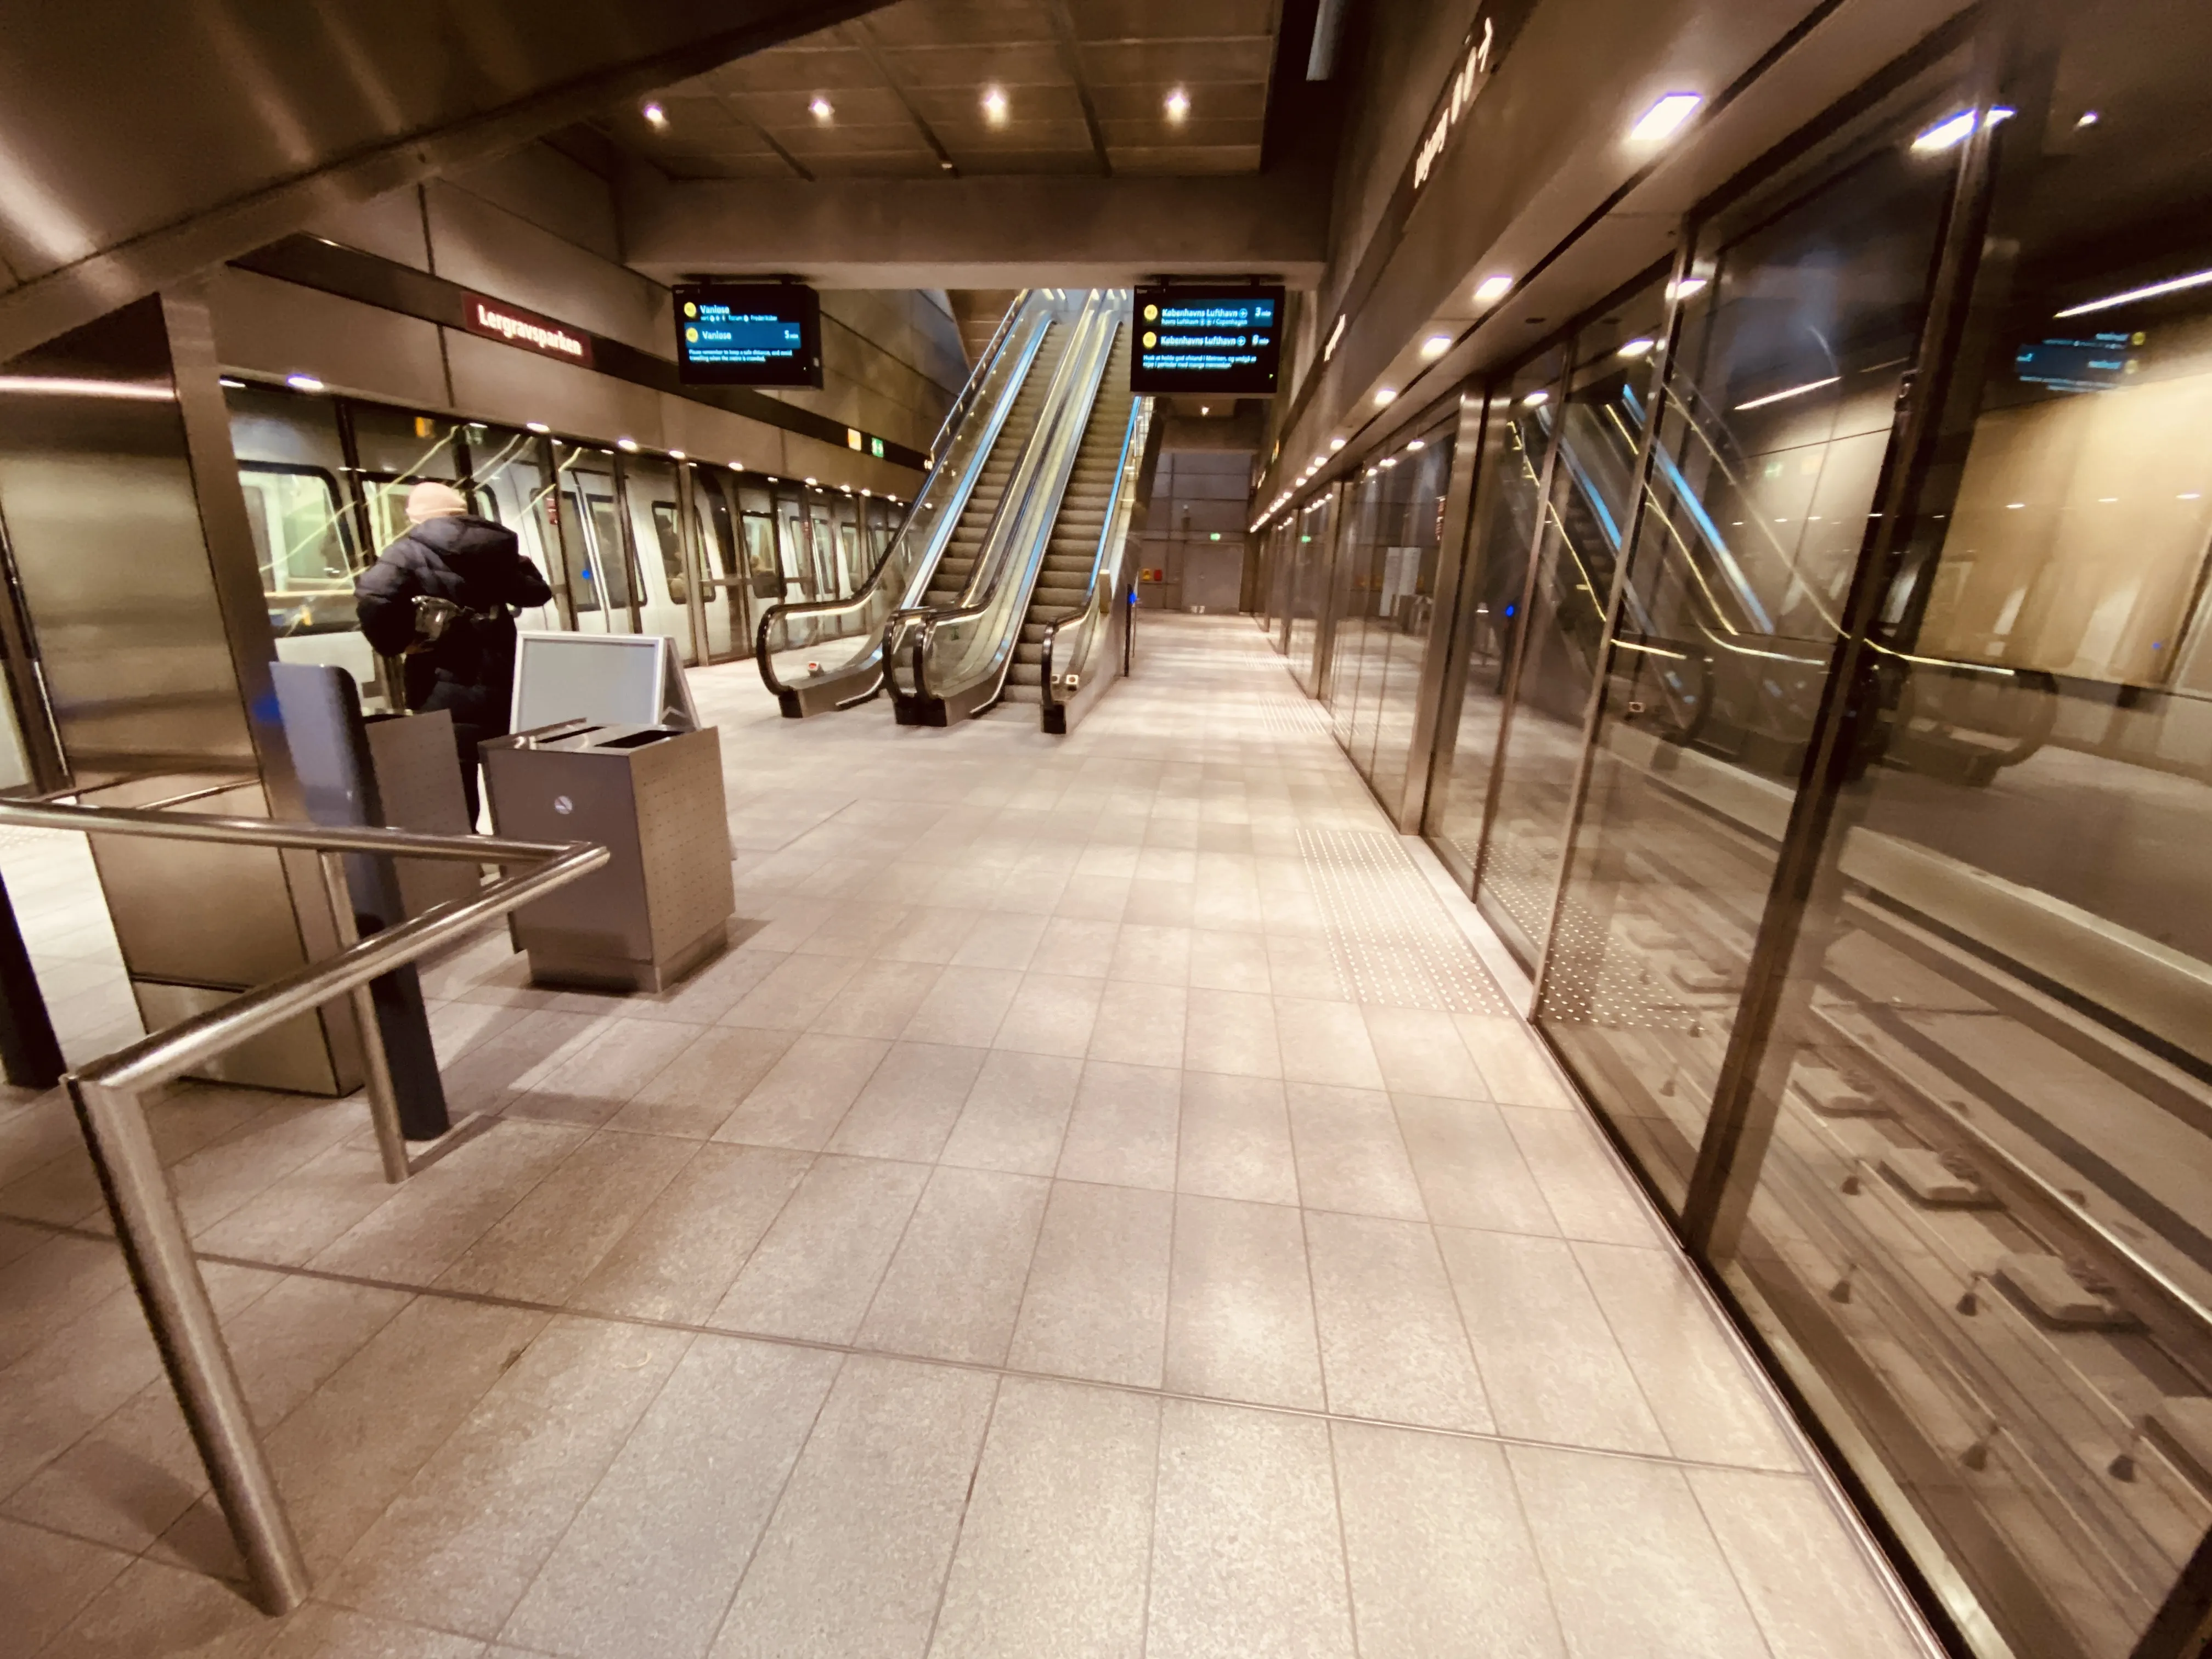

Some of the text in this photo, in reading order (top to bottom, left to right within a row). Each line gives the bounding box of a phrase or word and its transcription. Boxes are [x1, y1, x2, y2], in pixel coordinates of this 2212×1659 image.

[1162, 308, 1205, 317] Københavns
[1206, 308, 1238, 317] Lufthavn
[1255, 307, 1261, 317] 3
[477, 304, 582, 356] Lergravsparken
[1161, 335, 1204, 345] Københavns
[1205, 335, 1236, 345] Lufthavn
